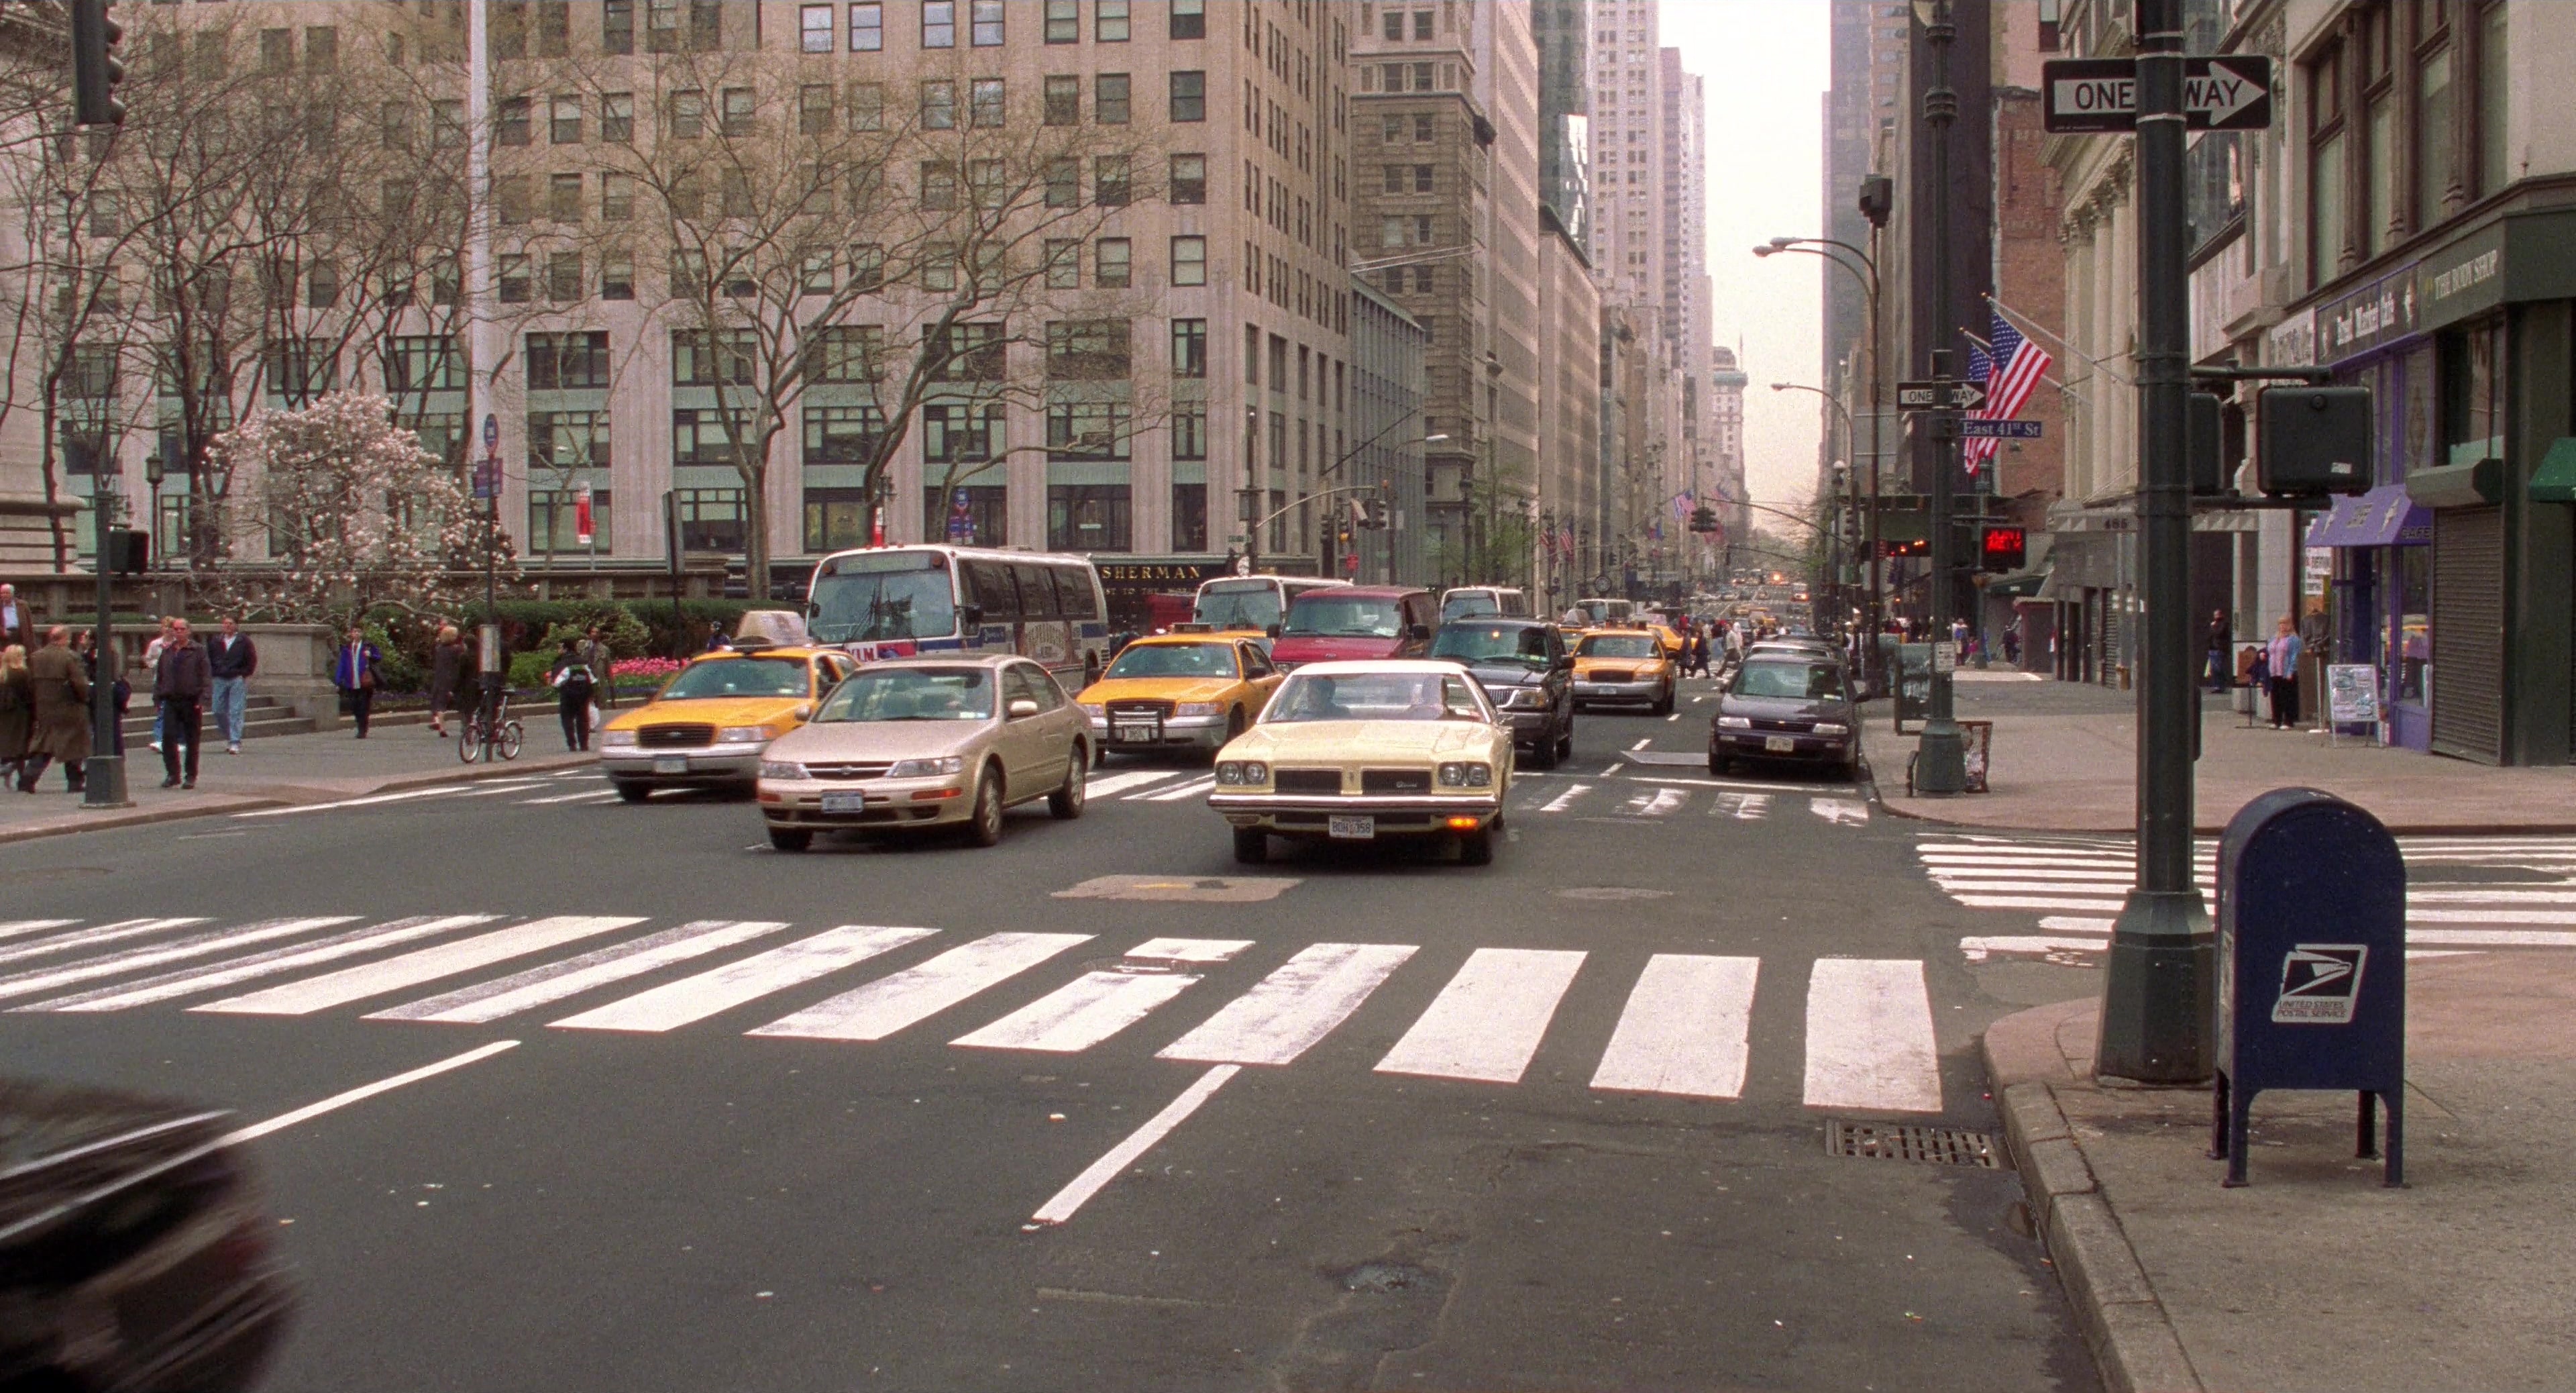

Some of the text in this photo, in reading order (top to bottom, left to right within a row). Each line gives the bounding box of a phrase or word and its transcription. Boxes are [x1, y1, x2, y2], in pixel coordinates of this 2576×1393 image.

[2076, 79, 2243, 110] ONE WAY
[1909, 391, 1933, 403] ONE
[1963, 422, 1993, 435] East
[2025, 422, 2040, 436] St
[1101, 566, 1199, 579] SHERMAN
[2281, 1000, 2345, 1009] UNITED STATES
[2277, 1009, 2346, 1018] POSTAL SERVICE
